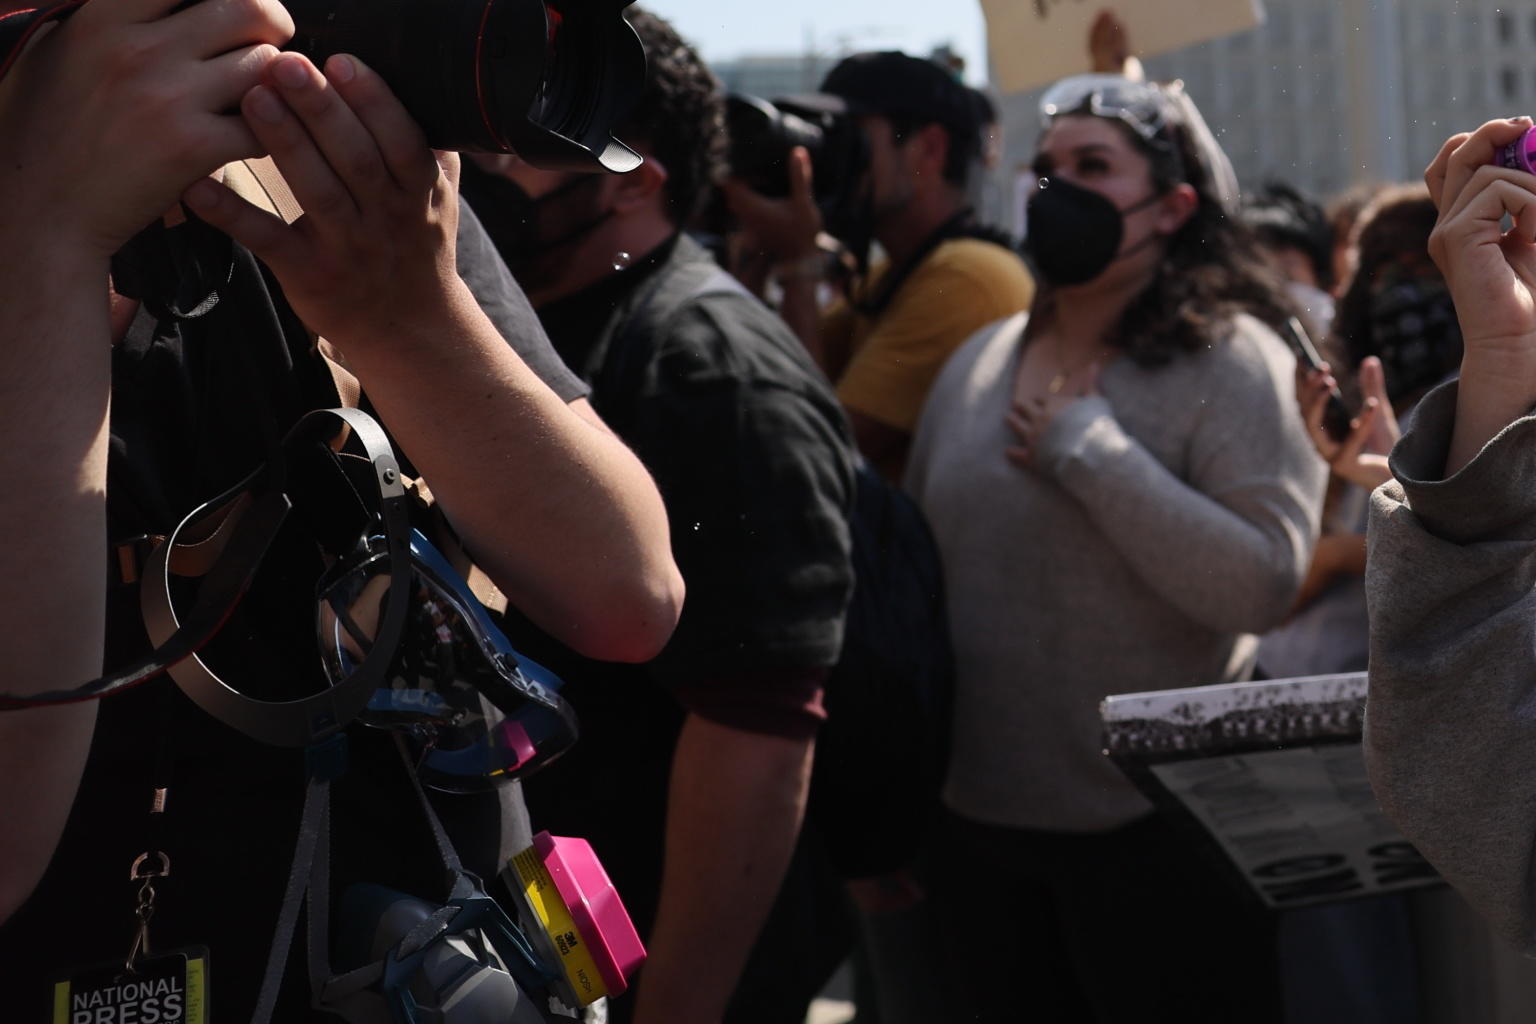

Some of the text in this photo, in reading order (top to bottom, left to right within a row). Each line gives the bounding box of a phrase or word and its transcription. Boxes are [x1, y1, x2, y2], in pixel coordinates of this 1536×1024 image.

[564, 931, 578, 947] 3M
[73, 976, 183, 1011] NATIONAL
[73, 994, 183, 1024] PRESS
